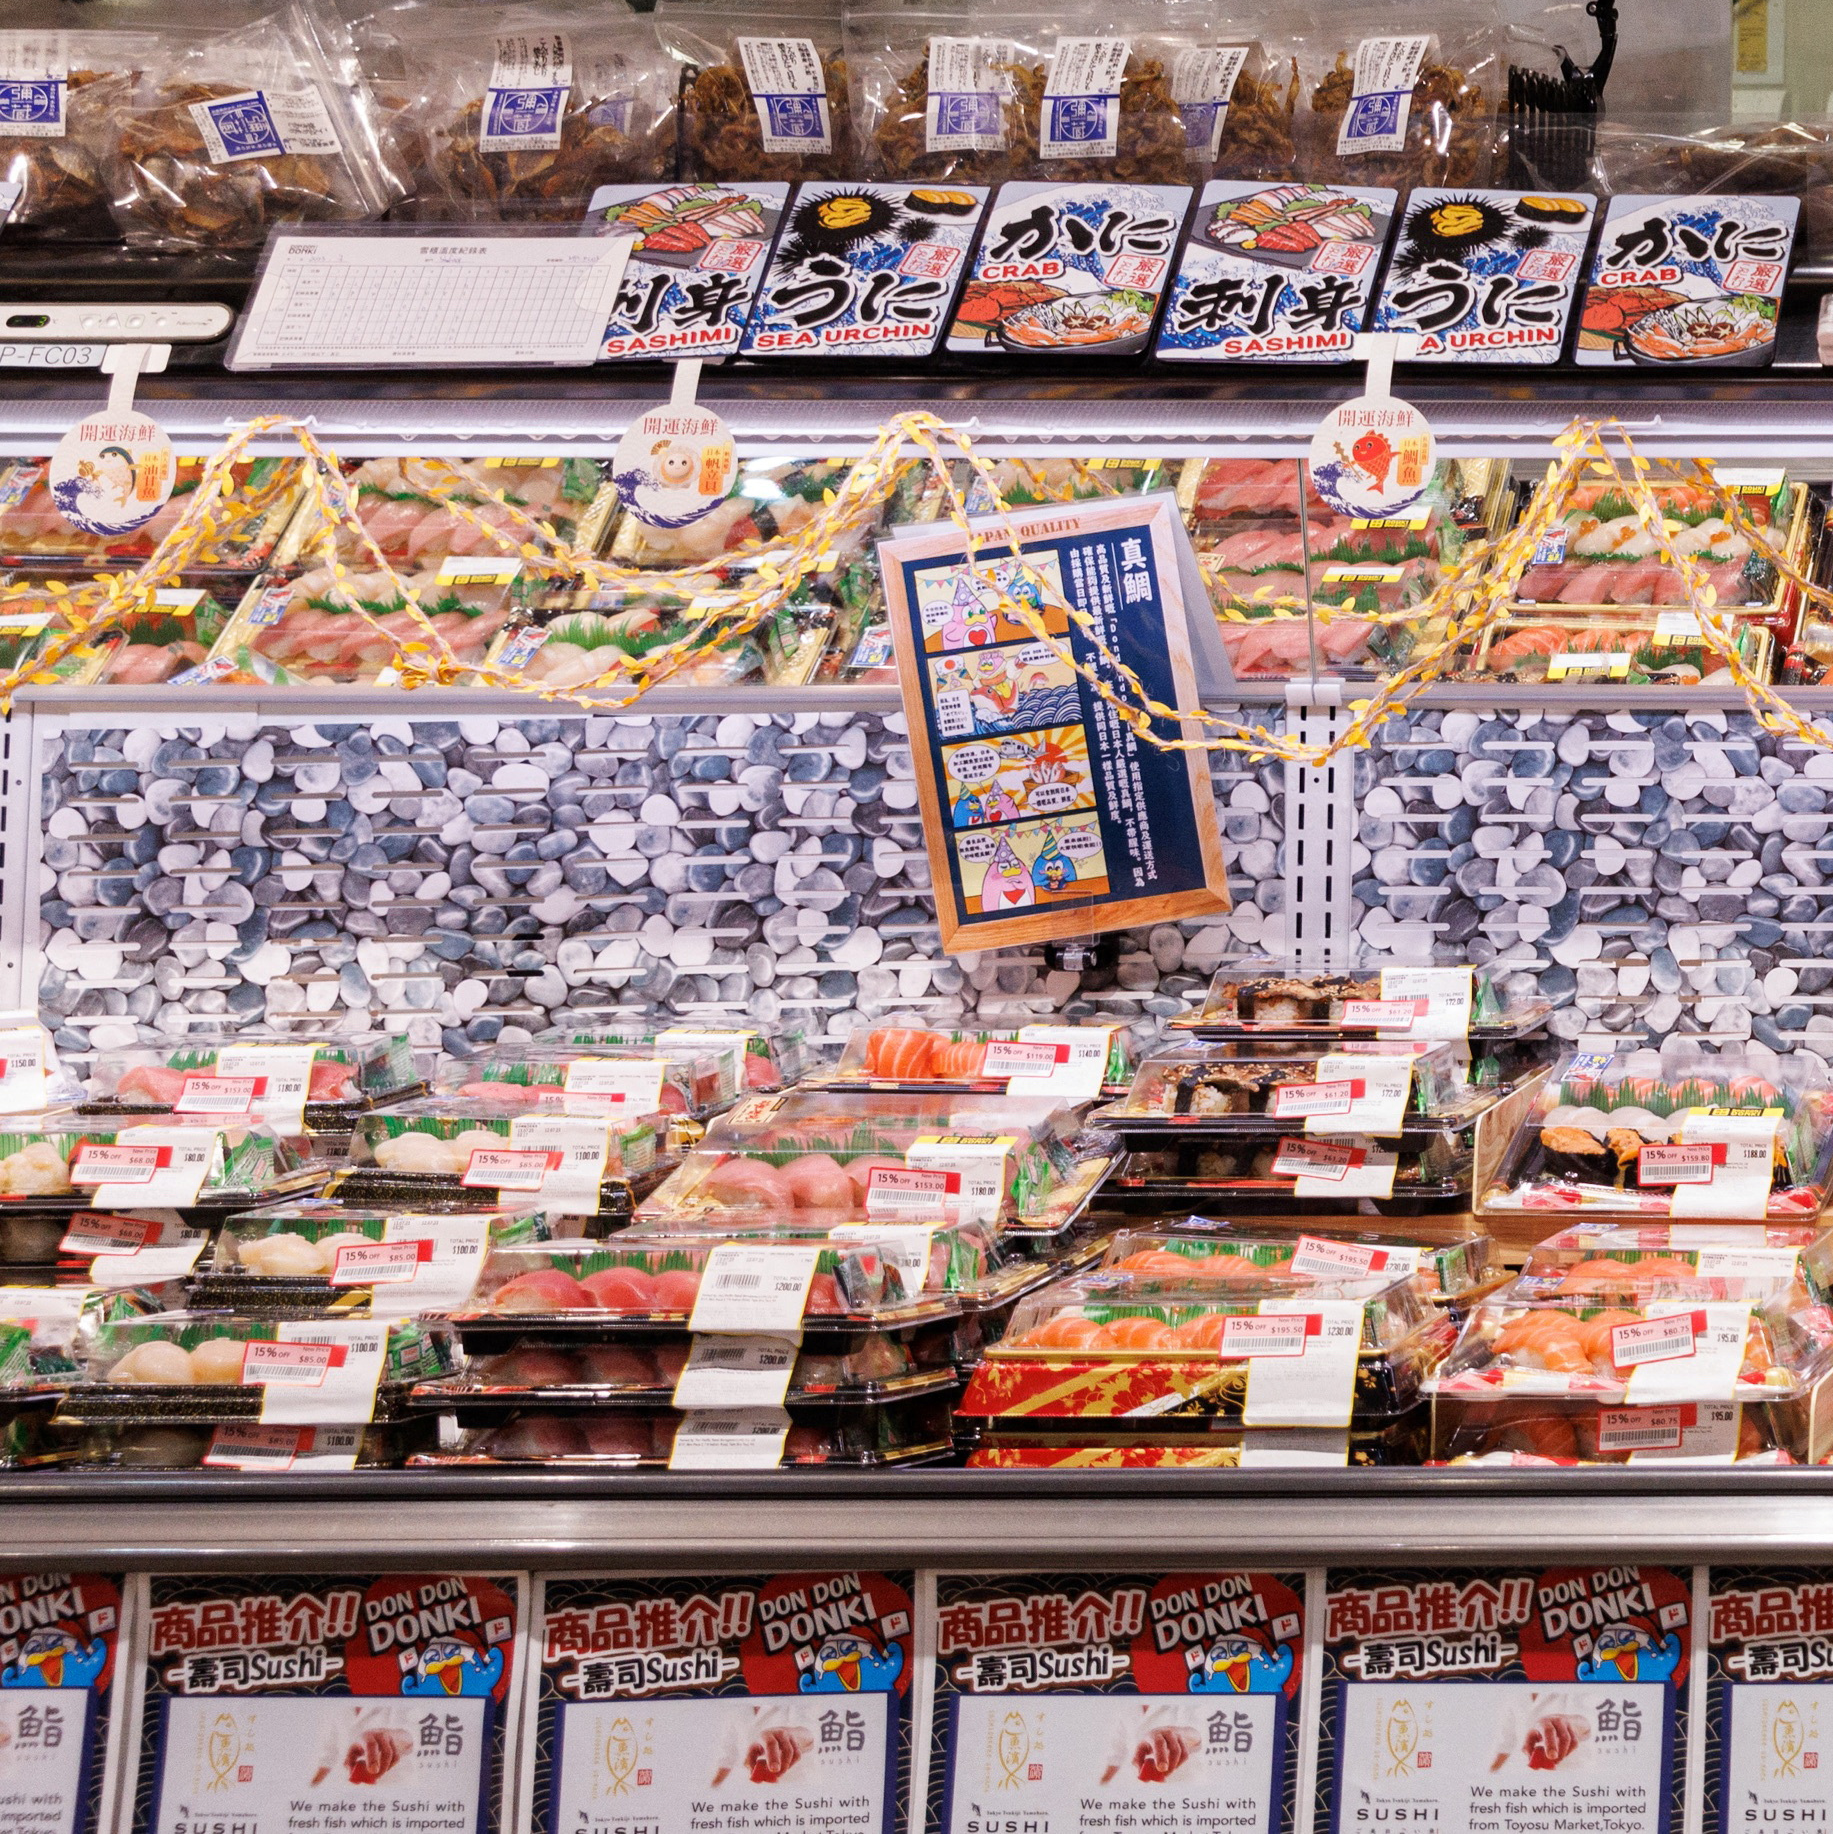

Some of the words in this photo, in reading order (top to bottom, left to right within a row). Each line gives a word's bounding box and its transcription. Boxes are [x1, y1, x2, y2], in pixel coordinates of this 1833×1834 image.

[989, 205, 1176, 262] かに
[1606, 217, 1787, 269] かに
[982, 264, 1060, 280] CRAB
[1601, 268, 1678, 284] CRAB
[767, 254, 950, 330] うに
[1391, 260, 1567, 333] うに
[1177, 274, 1364, 336] 刺身
[607, 327, 732, 354] SASHIMI
[757, 331, 812, 348] SEA
[825, 323, 931, 343] URCHIN
[1224, 333, 1348, 354] SASHIMI
[1451, 328, 1555, 347] URCHIN
[642, 417, 716, 436] 開運海鮮
[1339, 410, 1414, 427] 開運海鮮
[80, 424, 155, 442] 開運海鮮
[1020, 518, 1081, 539] QUALITY
[1121, 537, 1153, 604] 真鯛
[1645, 1150, 1666, 1160] 15%
[1681, 1154, 1710, 1162] $159.80
[1743, 1150, 1767, 1159] $188.00
[914, 1180, 944, 1190] $153.00
[773, 1282, 802, 1292] $200.00
[1271, 1324, 1304, 1334] $195.50
[1326, 1326, 1354, 1336] $230.00
[1663, 1325, 1689, 1337] $80.75
[1717, 1334, 1738, 1343] $95.00
[253, 1346, 276, 1357] 15%
[350, 1342, 378, 1353] $100.00
[298, 1355, 327, 1364] $85.00
[365, 1589, 414, 1622] DON
[759, 1591, 807, 1622] DON
[1327, 1580, 1531, 1639] 商品推介!!
[1543, 1583, 1655, 1639] DONKI
[939, 1591, 1145, 1651] 商品推介!!
[1595, 1698, 1642, 1743] 鮨
[1471, 1786, 1493, 1798] We
[1500, 1786, 1536, 1798] make
[1543, 1786, 1565, 1797] the
[1572, 1786, 1610, 1798] Sushi
[1616, 1786, 1646, 1797] with
[1357, 1808, 1439, 1821] SUSHI
[1470, 1802, 1500, 1815] fresh
[1506, 1802, 1526, 1815] fish
[1532, 1802, 1568, 1815] which
[1573, 1803, 1582, 1814] is
[1587, 1802, 1646, 1817] imported
[1745, 1809, 1827, 1822] SUSHI
[1469, 1819, 1499, 1831] from
[1504, 1819, 1547, 1834] Toyosu
